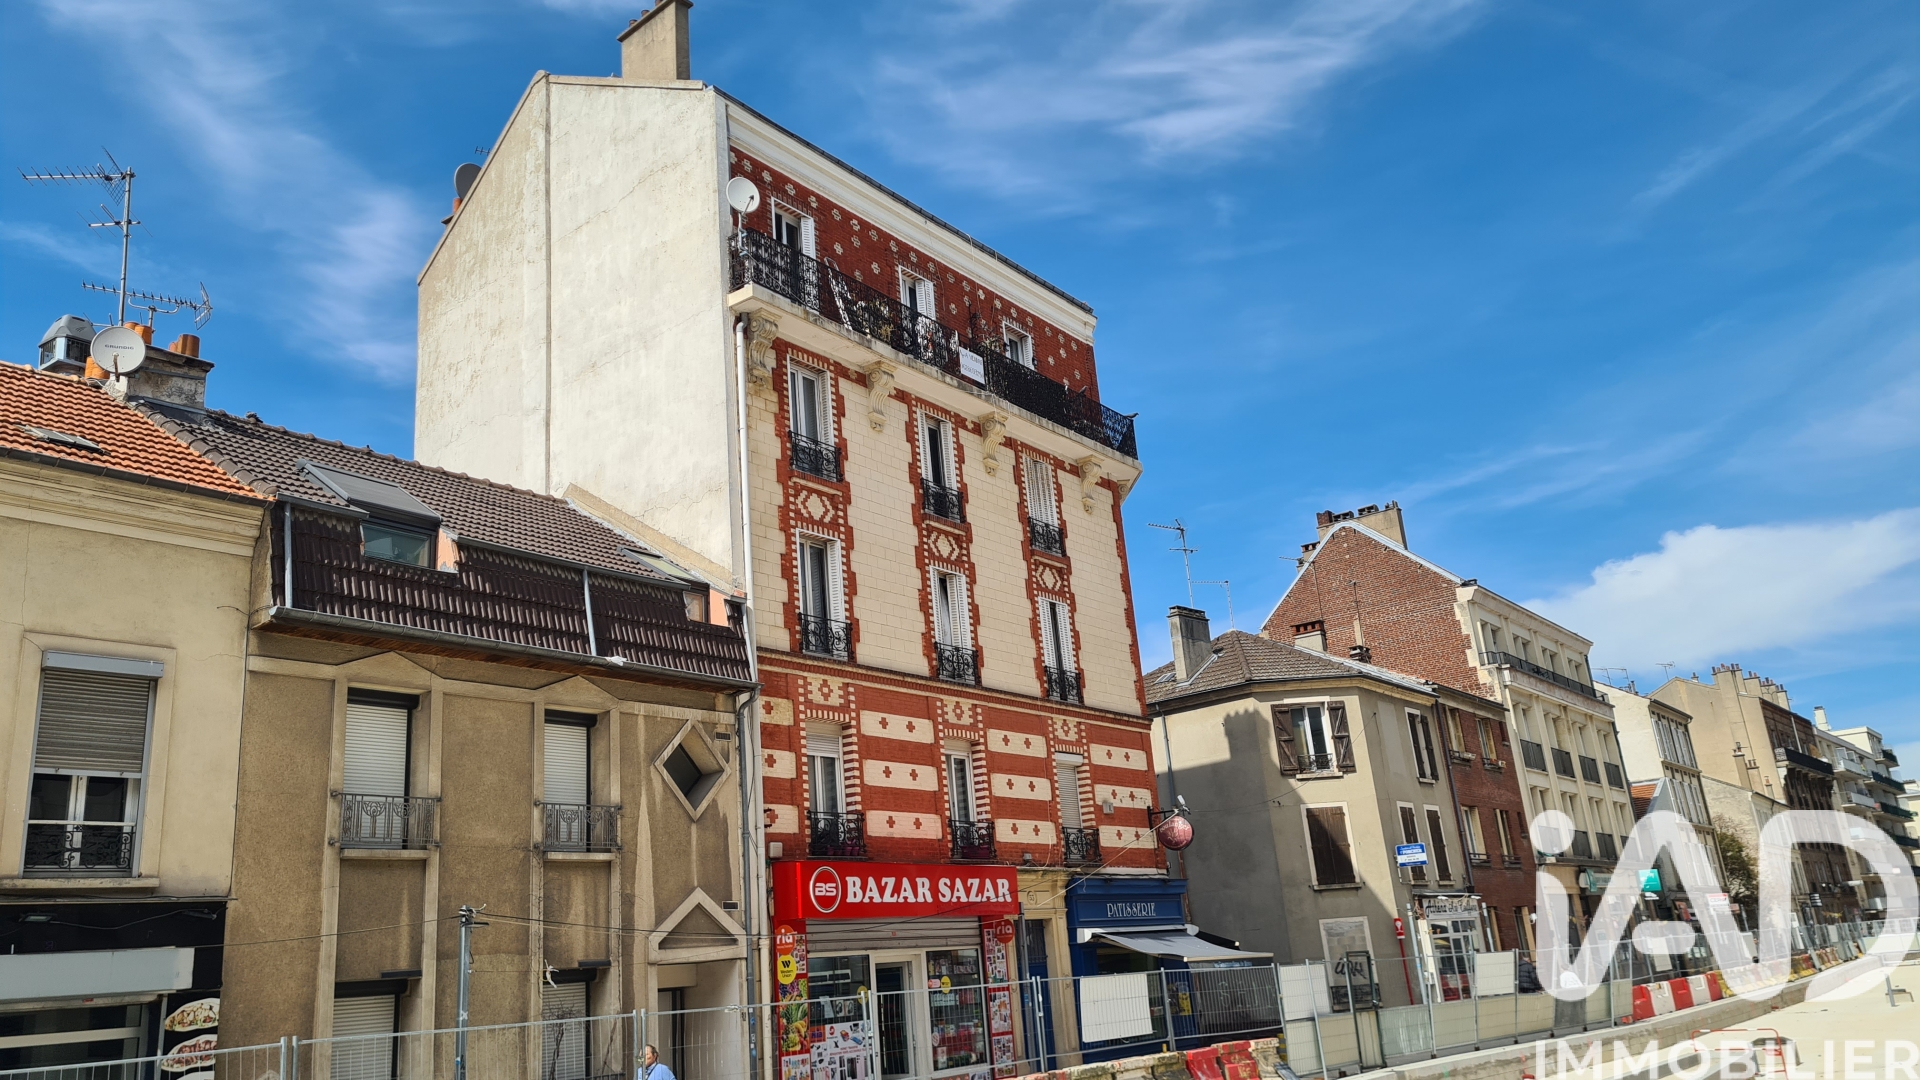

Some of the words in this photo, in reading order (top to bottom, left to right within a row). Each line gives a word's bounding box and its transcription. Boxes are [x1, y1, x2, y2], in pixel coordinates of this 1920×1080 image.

[815, 882, 837, 897] BS
[845, 876, 934, 903] BAZAR
[938, 877, 1013, 903] SAZAR
[1106, 902, 1157, 918] PATISSERIE
[996, 921, 1013, 935] ria
[776, 928, 794, 945] ria
